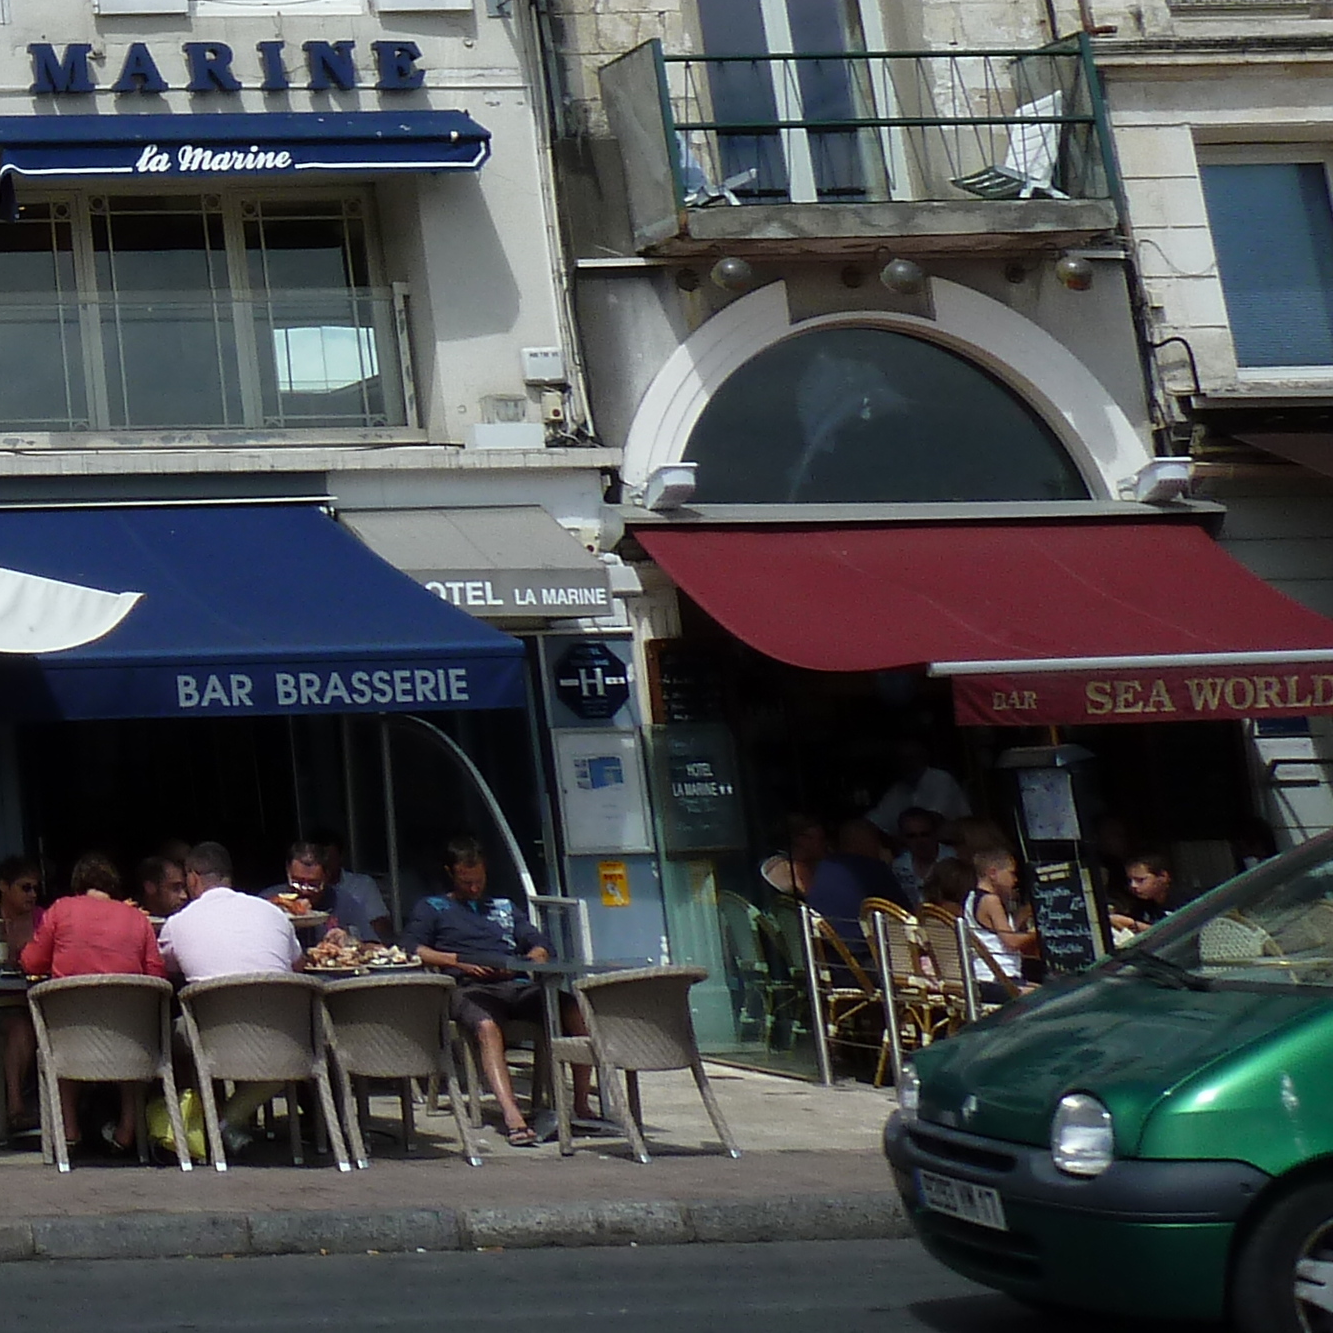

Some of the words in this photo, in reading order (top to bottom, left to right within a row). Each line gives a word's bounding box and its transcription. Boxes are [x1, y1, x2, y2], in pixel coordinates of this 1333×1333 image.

[28, 39, 427, 94] MARINE
[136, 144, 172, 173] la
[178, 144, 292, 172] Marine
[513, 588, 538, 606] LA
[542, 587, 608, 605] MARINE
[176, 673, 254, 708] BAR
[275, 668, 469, 706] BRASSERIE
[992, 690, 1038, 710] BAR
[1085, 678, 1177, 714] SEA
